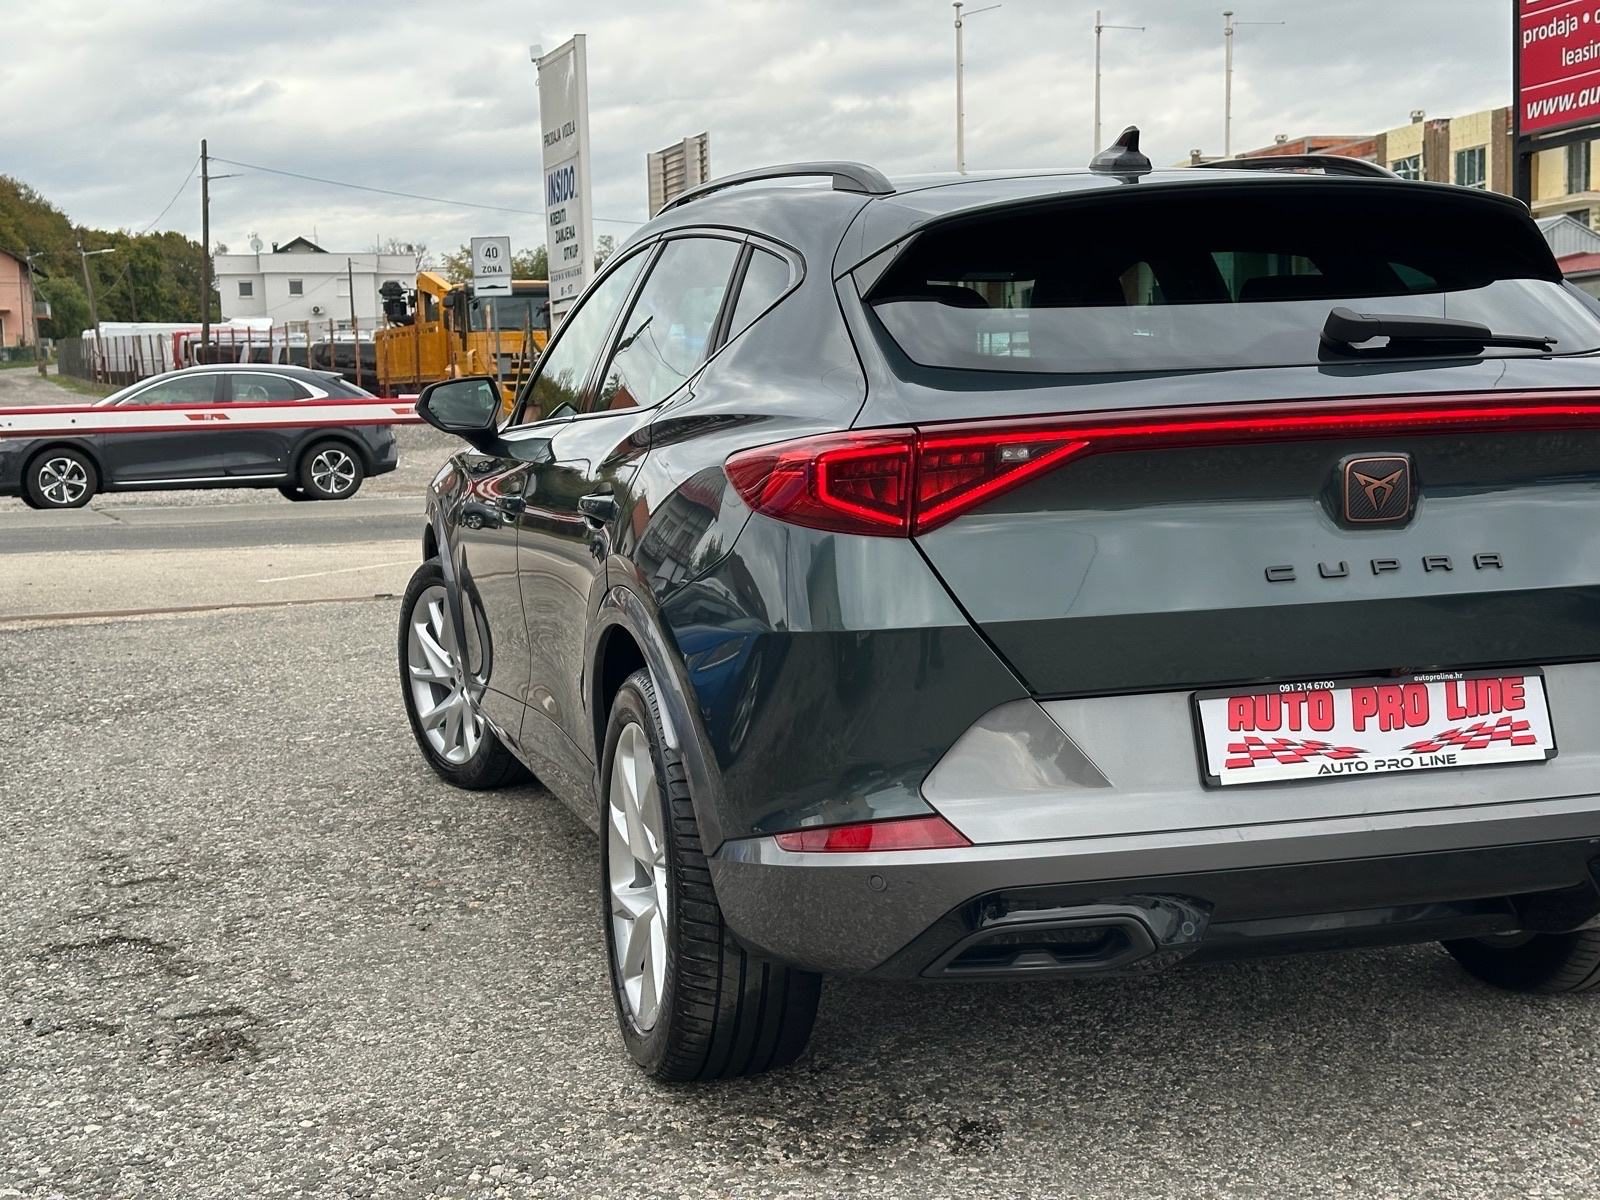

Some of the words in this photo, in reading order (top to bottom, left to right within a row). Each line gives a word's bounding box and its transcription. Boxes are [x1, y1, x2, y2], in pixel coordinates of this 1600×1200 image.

[1523, 13, 1578, 48] prodaja
[544, 127, 561, 148] PRODAJA
[562, 119, 575, 139] VOZILA
[547, 165, 575, 207] INSIDO
[550, 208, 567, 227] KREDITI
[555, 224, 576, 244] ZAMJENA
[485, 247, 498, 259] 40
[563, 243, 578, 261] OTKUP
[481, 265, 503, 274] ZONA
[1265, 552, 1504, 582] CUPRA
[1279, 683, 1295, 693] 091
[1297, 681, 1313, 692] 214
[1313, 680, 1335, 690] 6700
[1413, 671, 1463, 683] autoproline.hr
[1228, 691, 1335, 732] AUTO
[1351, 683, 1430, 732] PRO
[1318, 760, 1368, 775] AUTO
[1374, 757, 1414, 771] PRO
[1419, 753, 1457, 767] LINE
